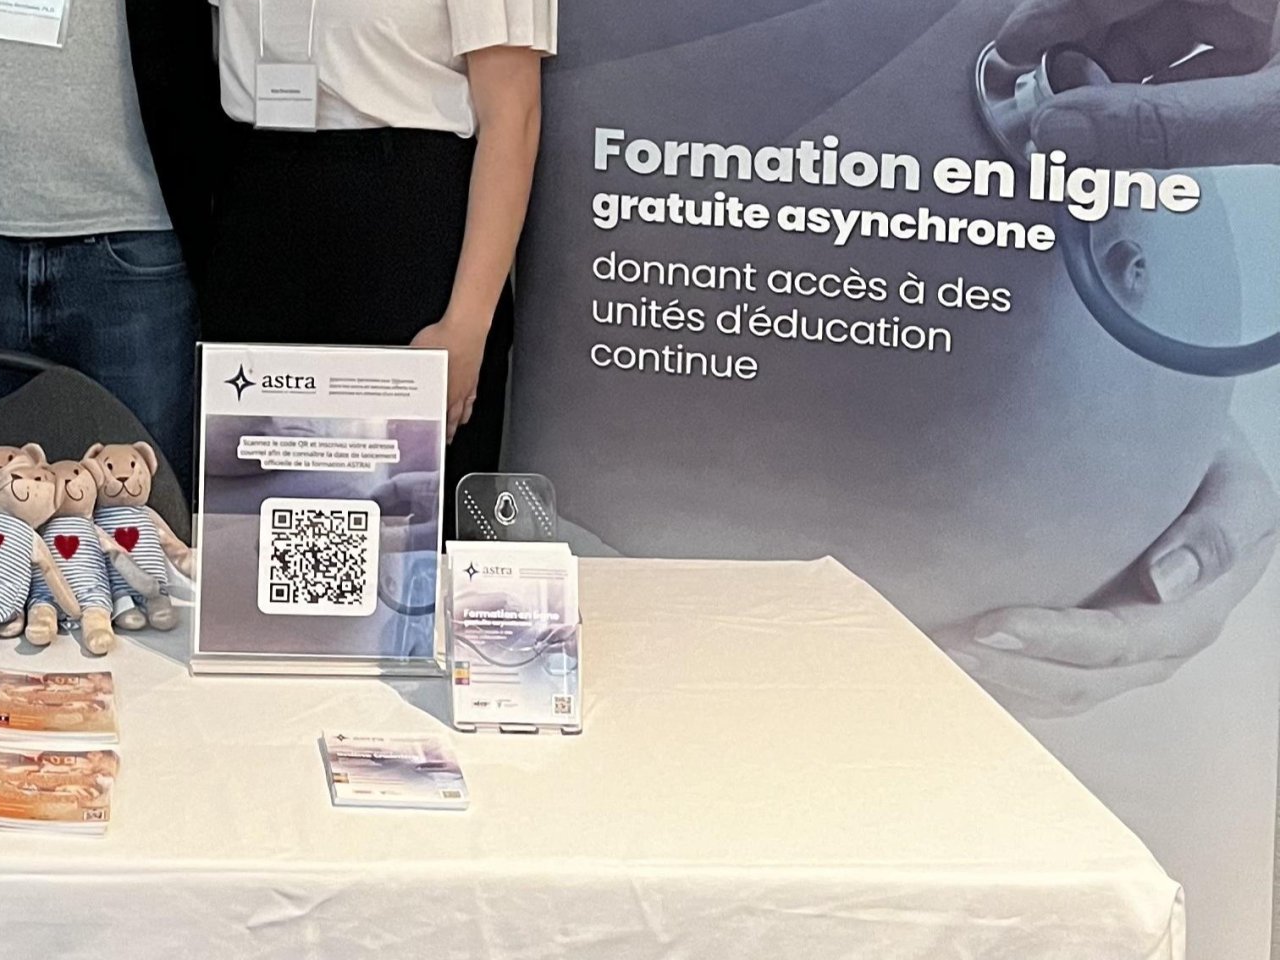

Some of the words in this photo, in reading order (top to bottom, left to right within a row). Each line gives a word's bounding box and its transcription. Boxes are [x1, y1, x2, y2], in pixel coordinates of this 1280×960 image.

[595, 128, 919, 190] Formation
[934, 158, 1014, 197] en
[1030, 150, 1199, 221] ligne
[593, 192, 769, 229] gratuite
[778, 206, 1055, 250] asynchrone
[593, 251, 756, 290] donnant
[768, 267, 886, 300] accès
[900, 272, 924, 304] à
[938, 277, 1010, 311] des
[593, 297, 704, 331] unités
[717, 303, 950, 352] d'éducation
[262, 373, 316, 389] astra
[591, 344, 757, 378] continue
[298, 440, 308, 448] QR
[482, 565, 513, 575] astra
